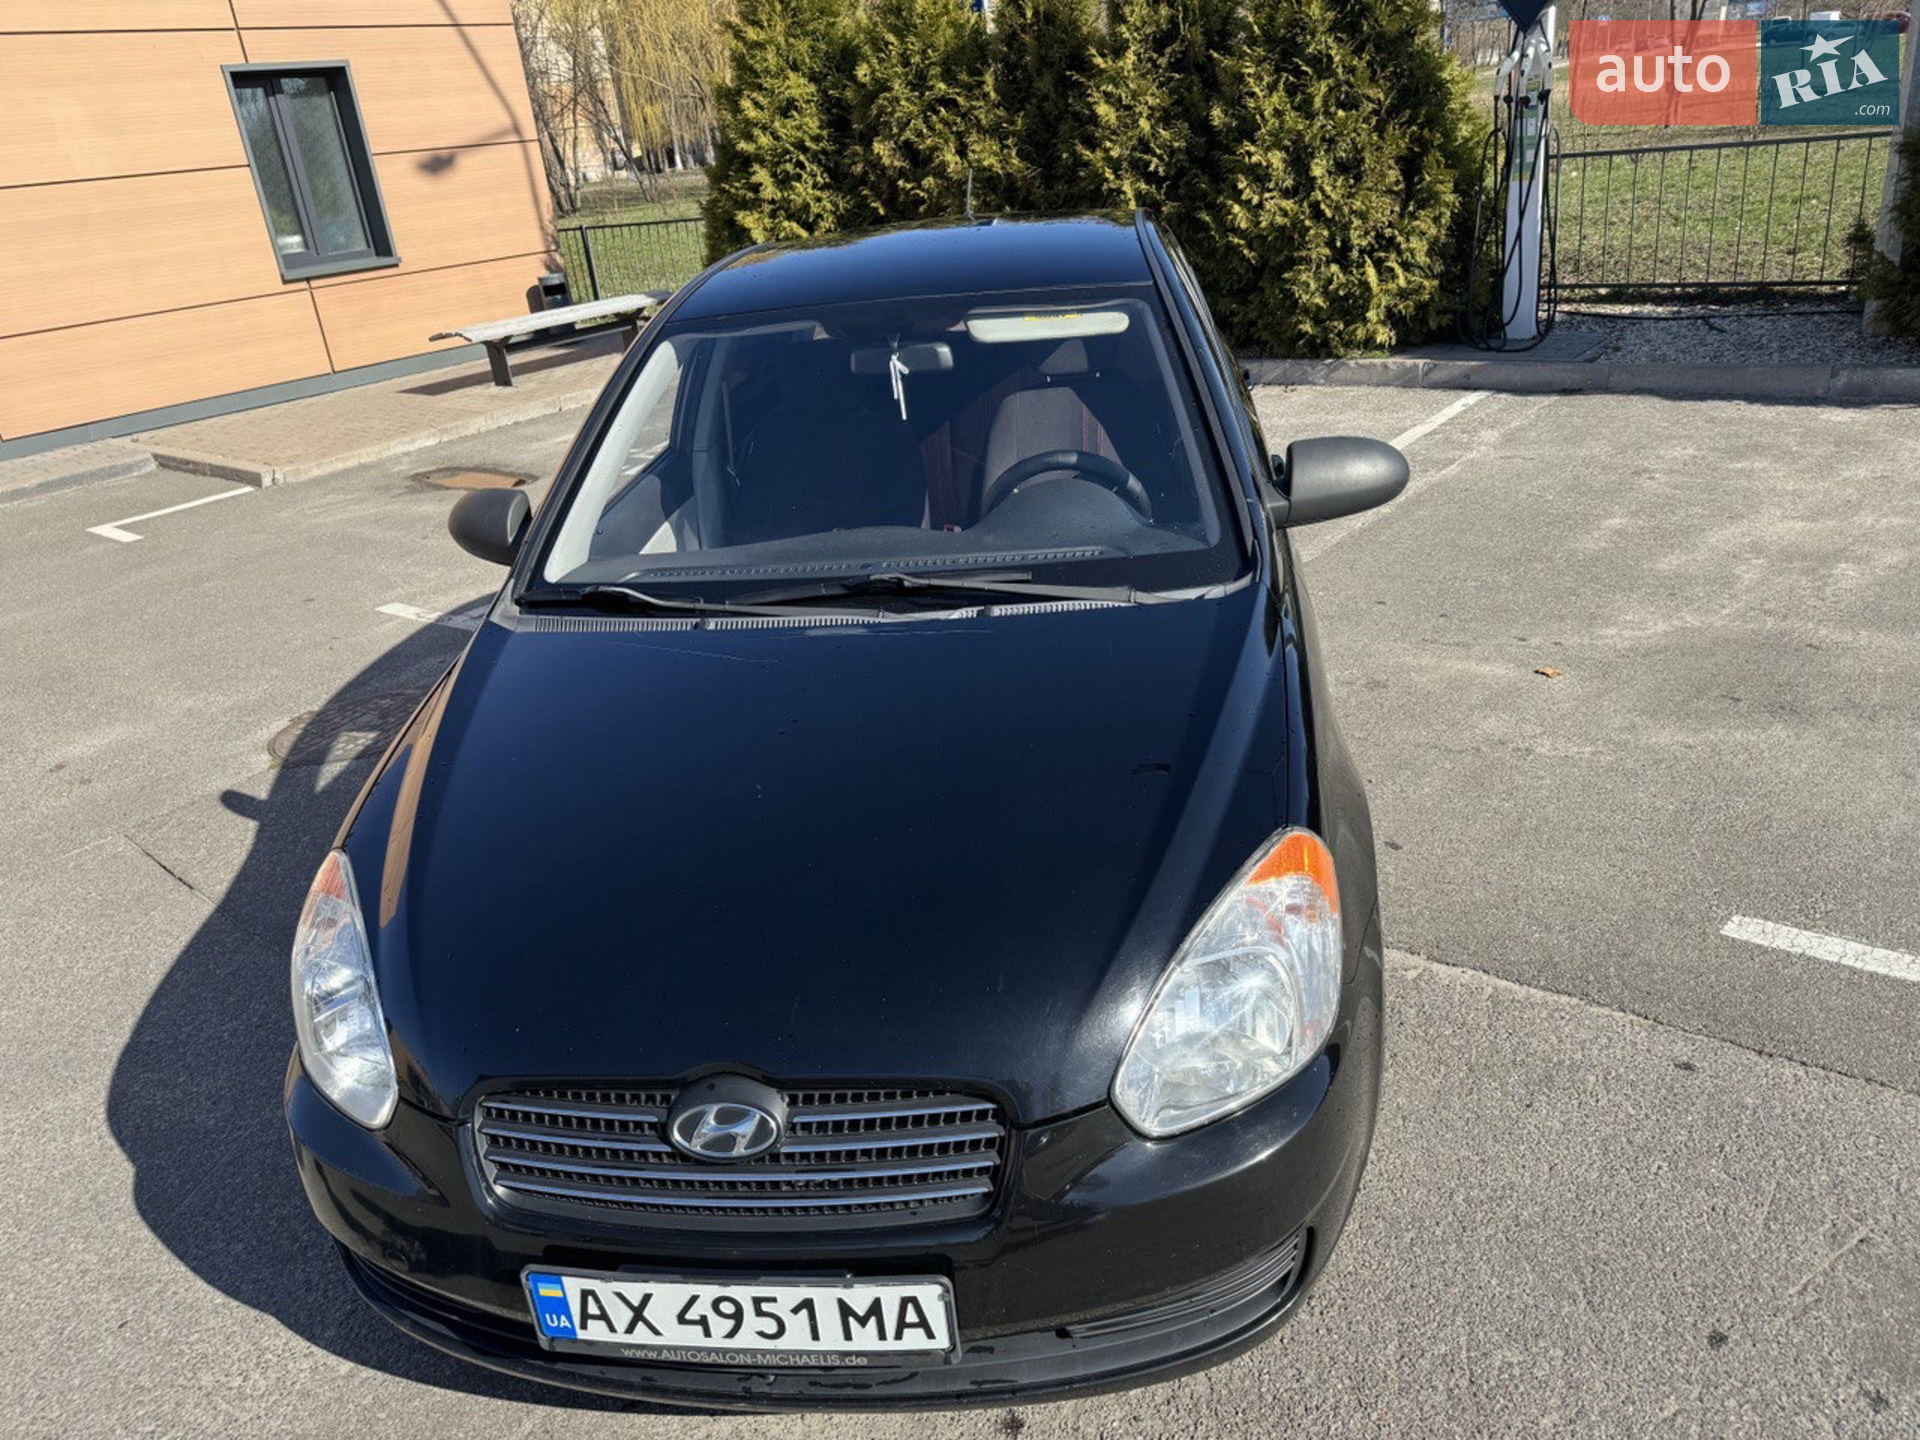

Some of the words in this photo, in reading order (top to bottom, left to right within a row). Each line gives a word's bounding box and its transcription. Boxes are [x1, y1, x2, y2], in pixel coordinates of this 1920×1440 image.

[546, 1313, 571, 1329] UA
[578, 1288, 663, 1336] AX
[676, 1294, 821, 1341] 4951
[836, 1296, 936, 1341] MA
[621, 1346, 868, 1366] www.AUTOSALON-MICHAELIS.de
